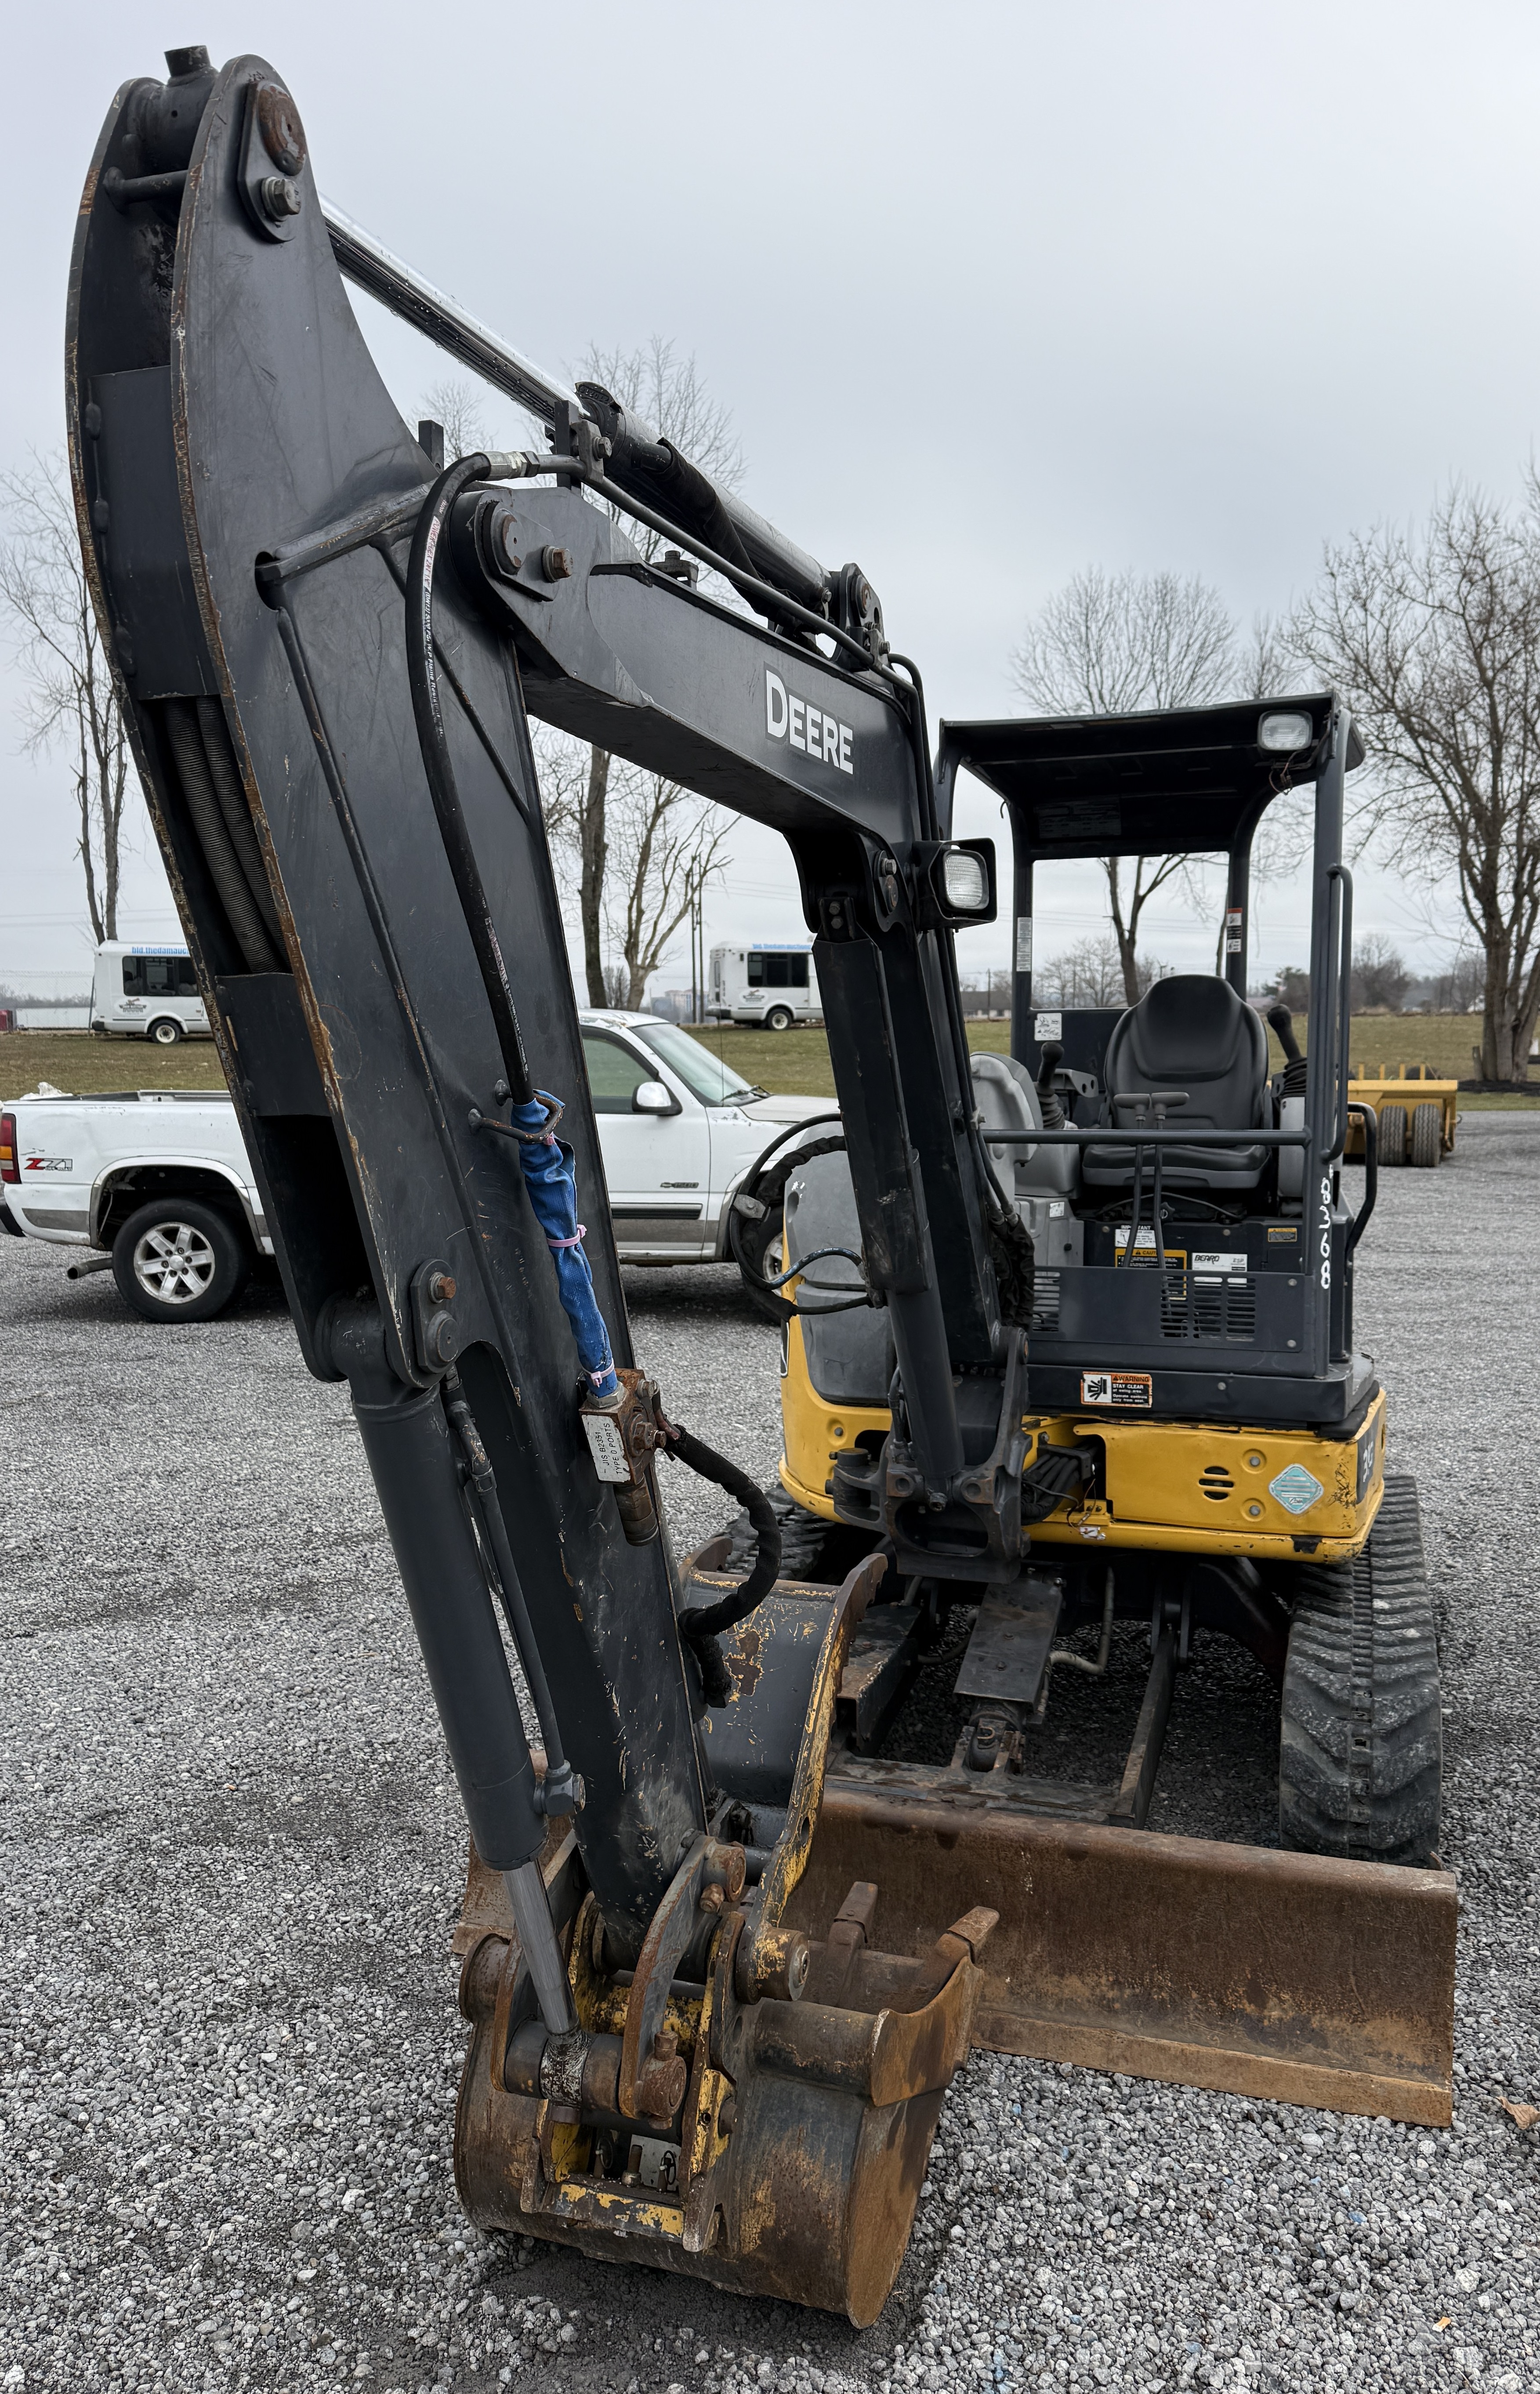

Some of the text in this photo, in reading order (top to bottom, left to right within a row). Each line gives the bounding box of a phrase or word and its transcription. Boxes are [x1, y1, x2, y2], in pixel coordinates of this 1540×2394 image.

[766, 670, 853, 775] DEERE
[24, 1158, 72, 1171] Z71
[603, 1423, 616, 1448] PORTS
[595, 1431, 610, 1466] JIS B2351
[612, 1456, 623, 1474] TYPE
